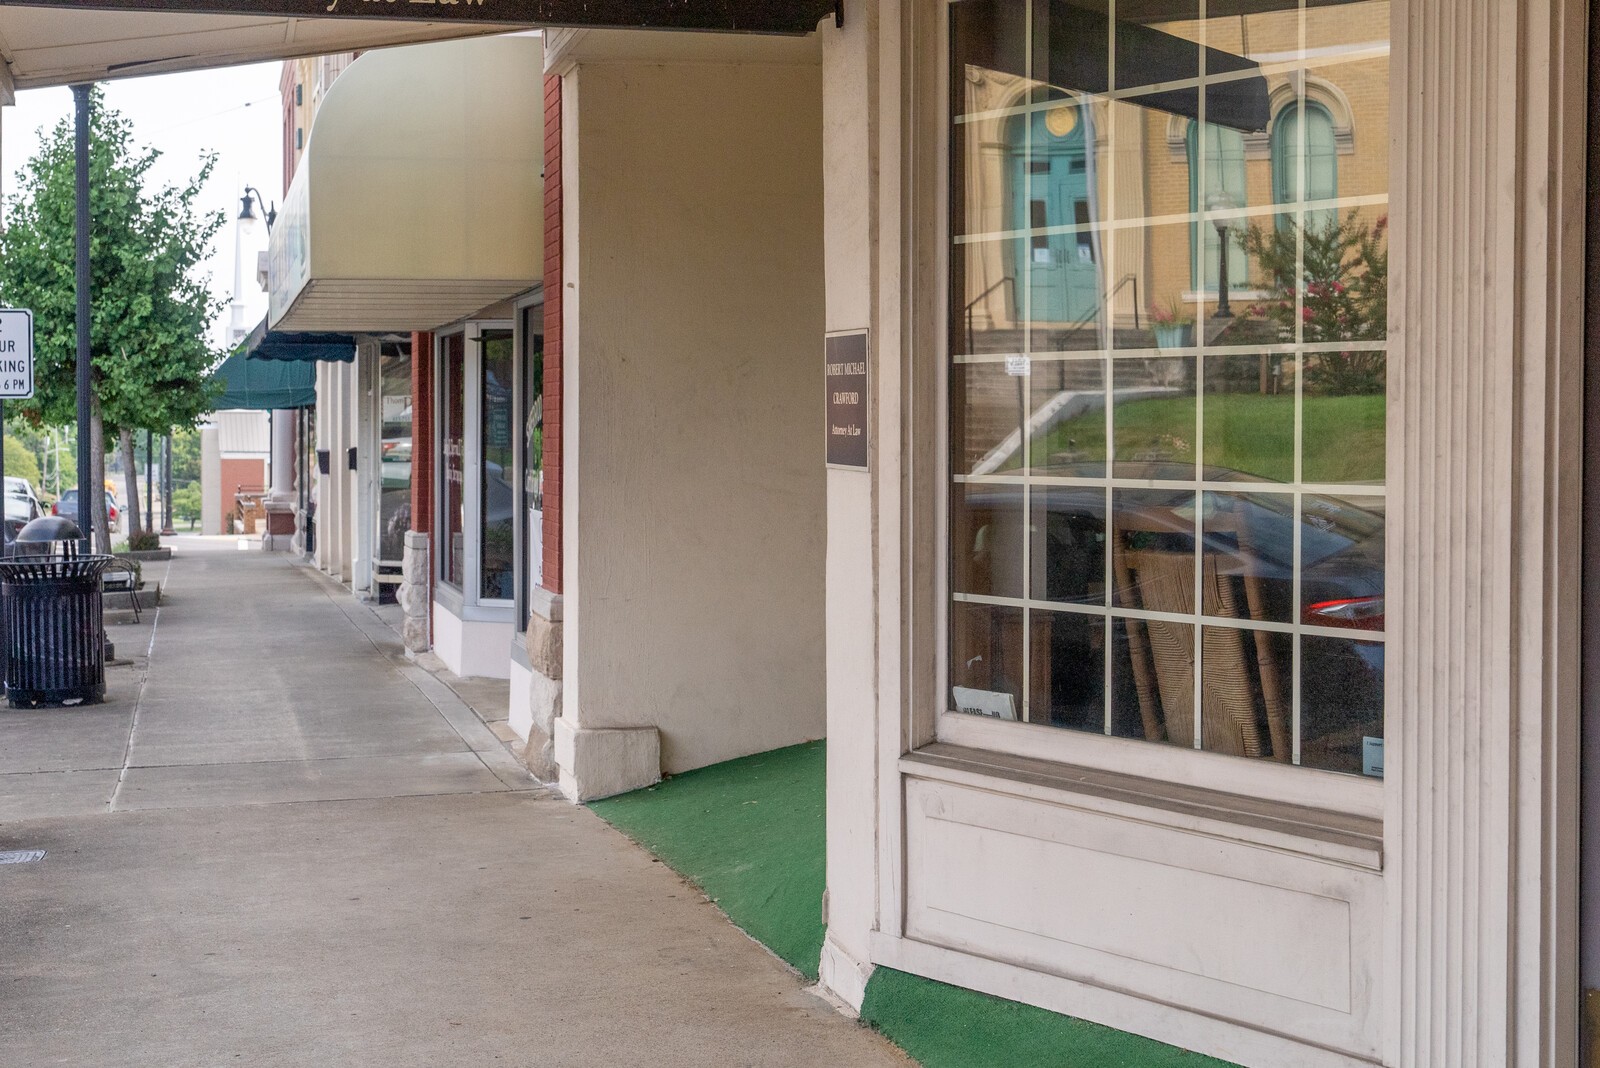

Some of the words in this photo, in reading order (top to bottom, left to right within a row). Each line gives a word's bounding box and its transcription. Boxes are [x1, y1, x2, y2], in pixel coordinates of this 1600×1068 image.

[827, 363, 843, 376] ROBERT
[844, 362, 866, 375] MICHAEL
[4, 380, 9, 390] 6
[13, 379, 25, 390] PM
[833, 392, 859, 405] CRAWFORD
[832, 424, 847, 437] Attorney
[853, 424, 861, 436] Law
